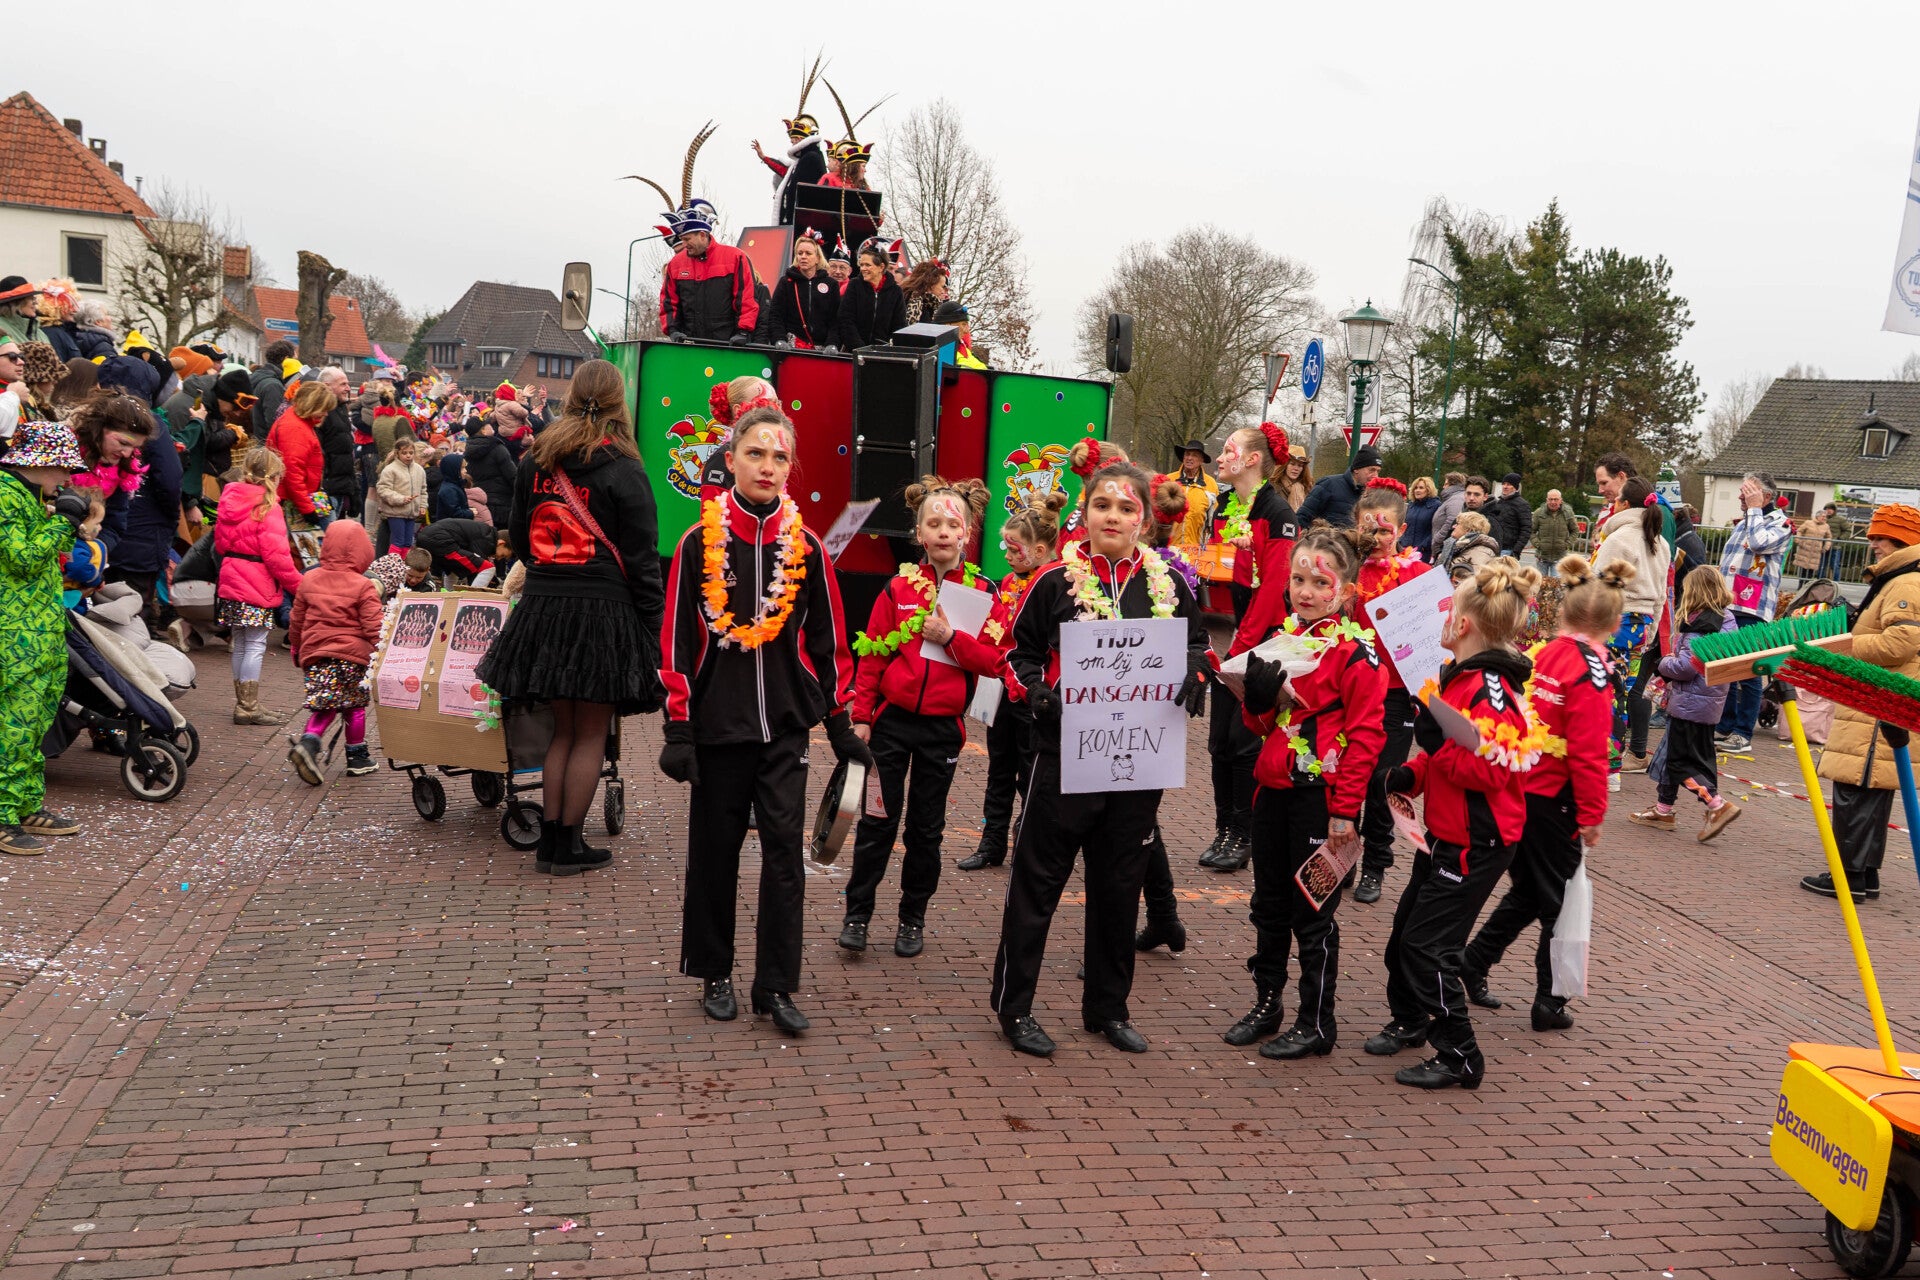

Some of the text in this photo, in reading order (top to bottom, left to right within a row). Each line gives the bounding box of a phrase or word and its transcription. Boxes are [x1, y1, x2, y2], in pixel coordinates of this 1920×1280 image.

[670, 472, 702, 496] CV de KOF
[1092, 627, 1146, 649] TIJD
[1076, 651, 1165, 680] om bij de
[1065, 682, 1184, 705] DANSGARDE
[1111, 712, 1125, 721] TE
[1077, 726, 1167, 760] KOMEN
[1775, 1093, 1869, 1192] Bezemwagen
